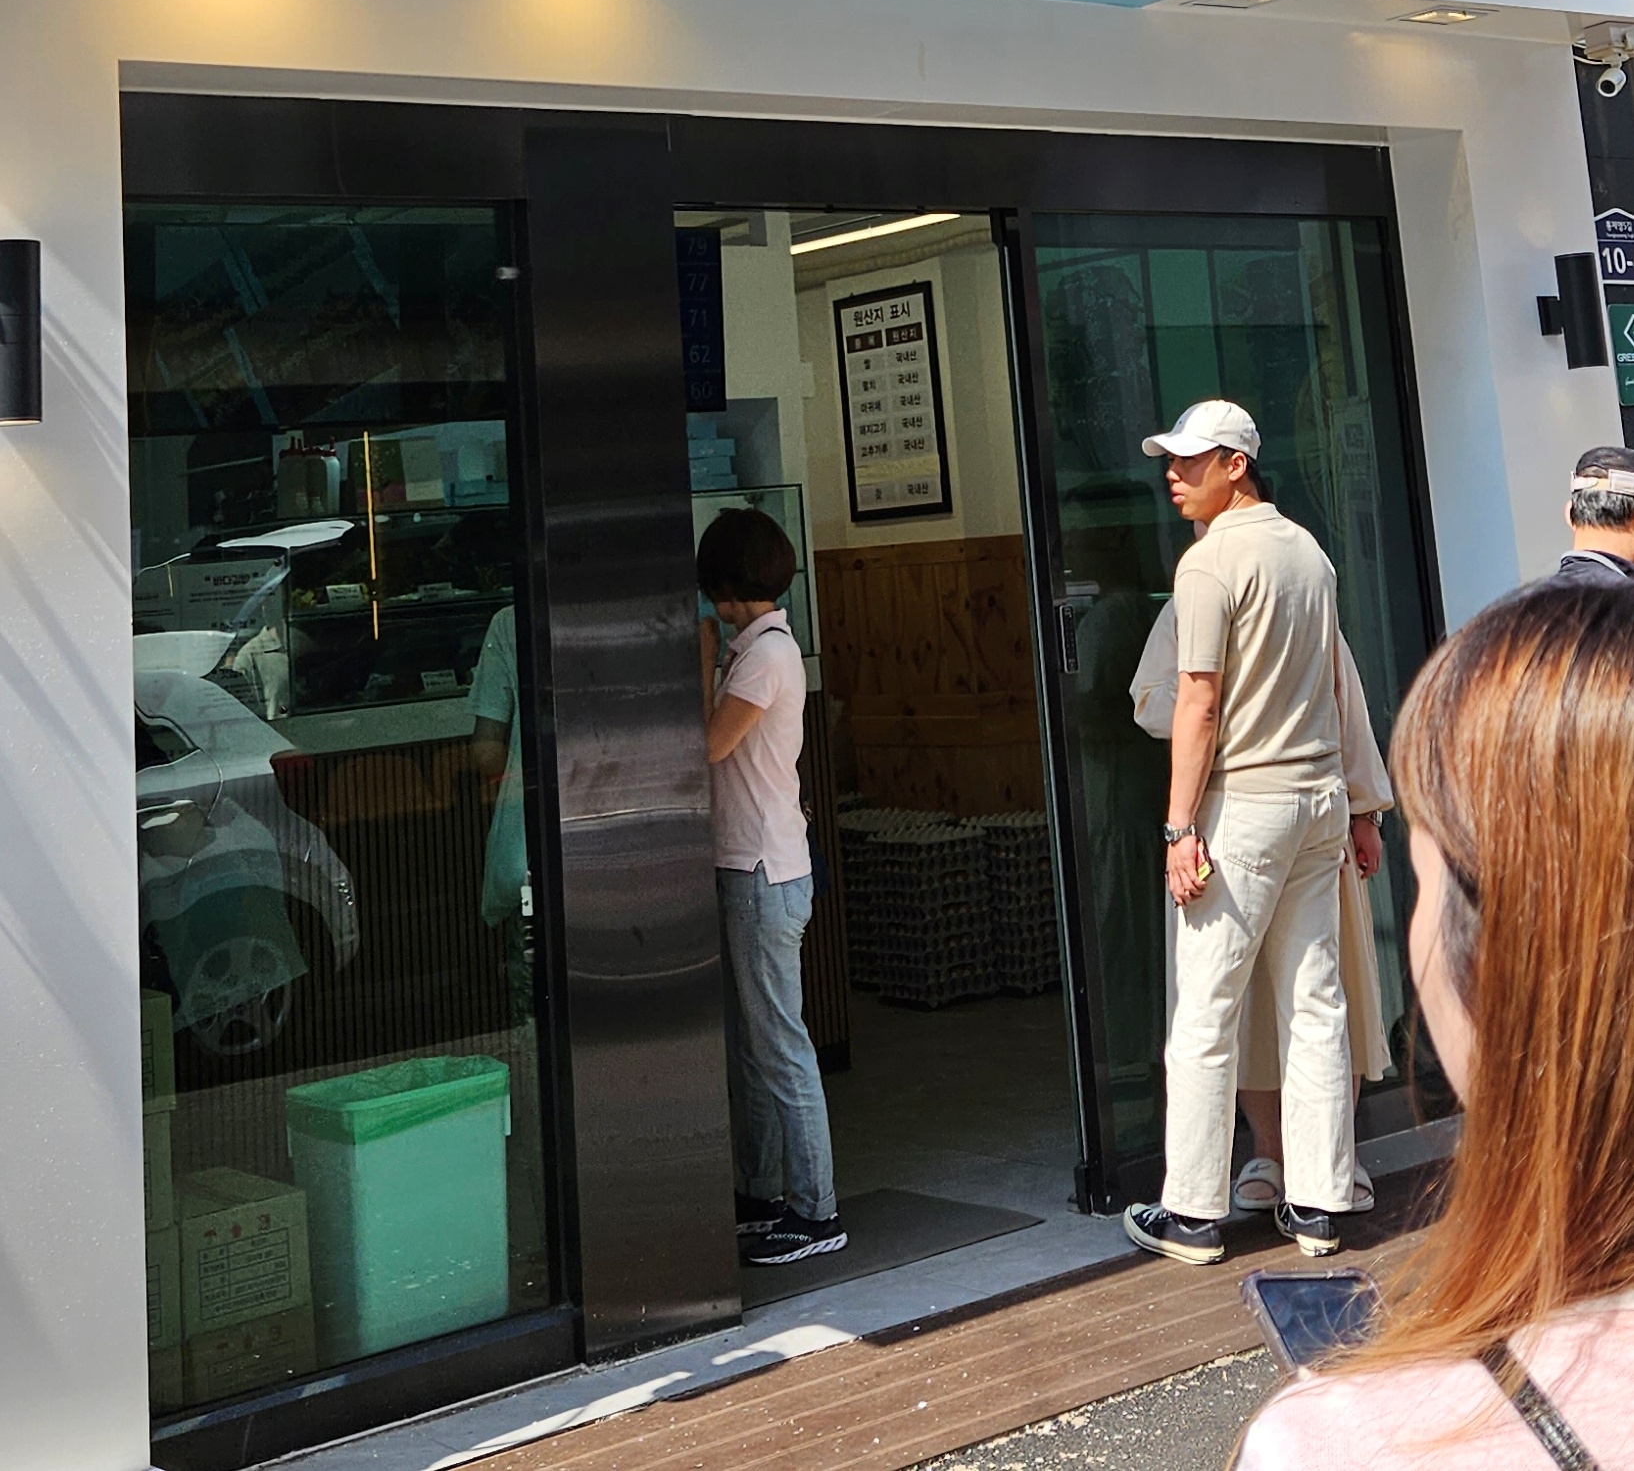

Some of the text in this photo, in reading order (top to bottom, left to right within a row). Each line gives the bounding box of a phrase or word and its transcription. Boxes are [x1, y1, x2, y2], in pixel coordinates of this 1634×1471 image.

[686, 236, 708, 256] 79
[686, 272, 709, 292] 77
[688, 309, 708, 328] 71
[853, 300, 911, 327] 원산지 표시
[688, 344, 711, 363] 62
[896, 350, 917, 363] 국내산
[897, 371, 919, 384] 국내산
[900, 393, 921, 406] 국내산
[902, 416, 923, 428] 국내산
[903, 438, 925, 451] 국내산
[907, 483, 929, 495] 국내산
